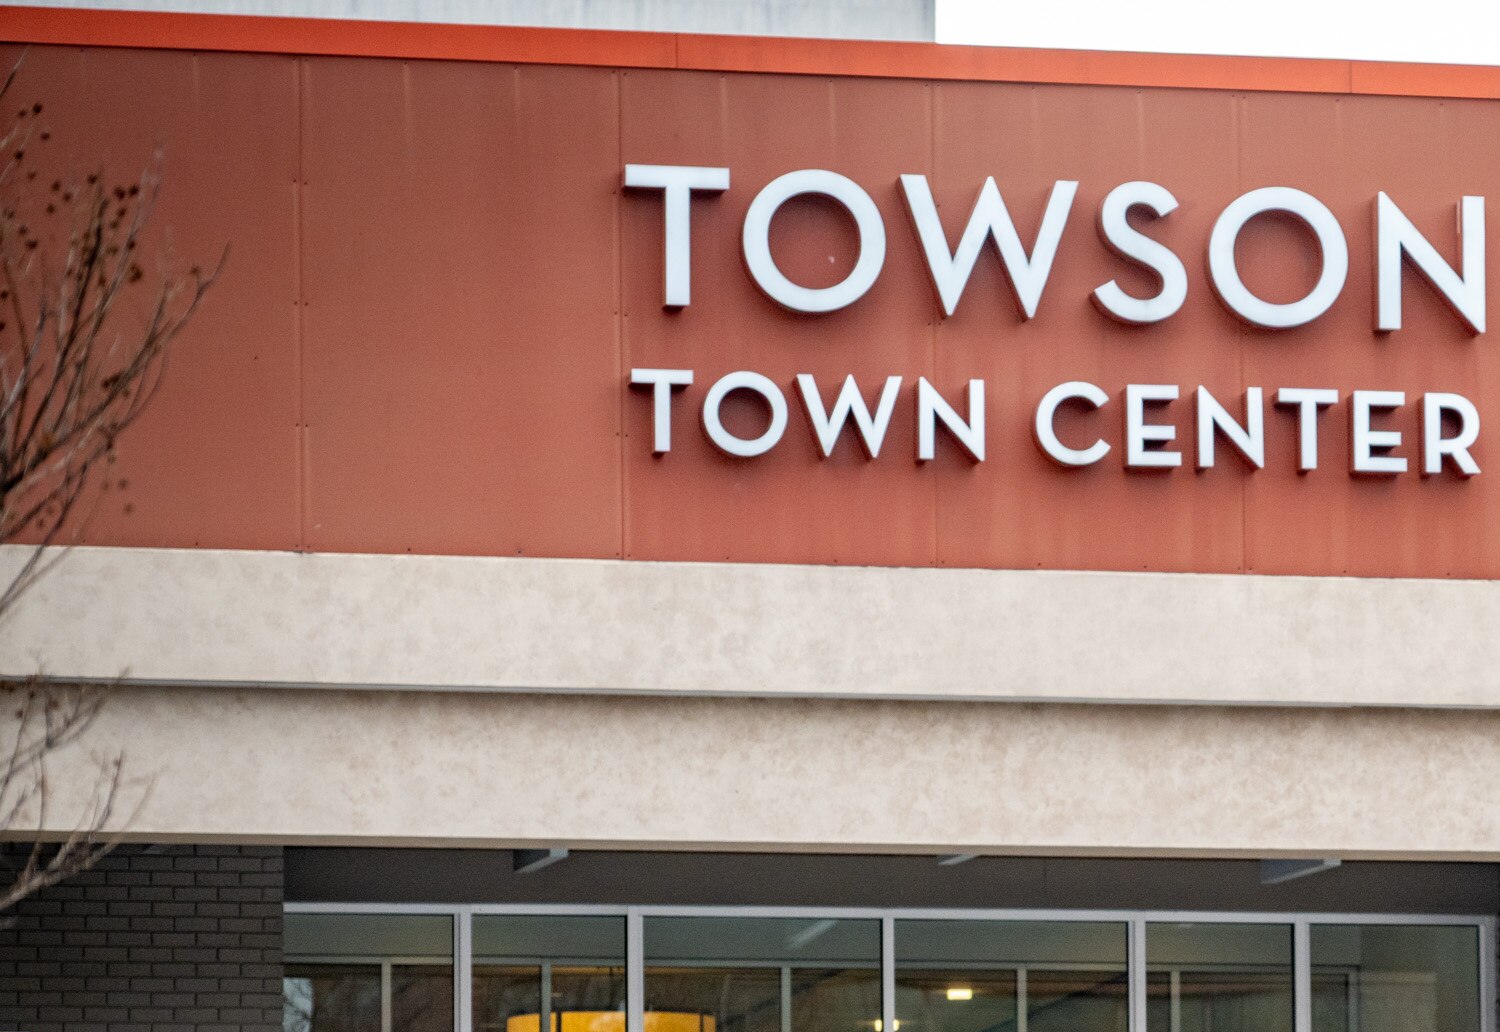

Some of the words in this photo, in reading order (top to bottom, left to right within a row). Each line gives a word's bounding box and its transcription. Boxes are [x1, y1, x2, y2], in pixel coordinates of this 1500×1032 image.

[623, 163, 1487, 335] TOWSON
[630, 367, 985, 463] TOWN
[1034, 381, 1482, 477] CENTER
